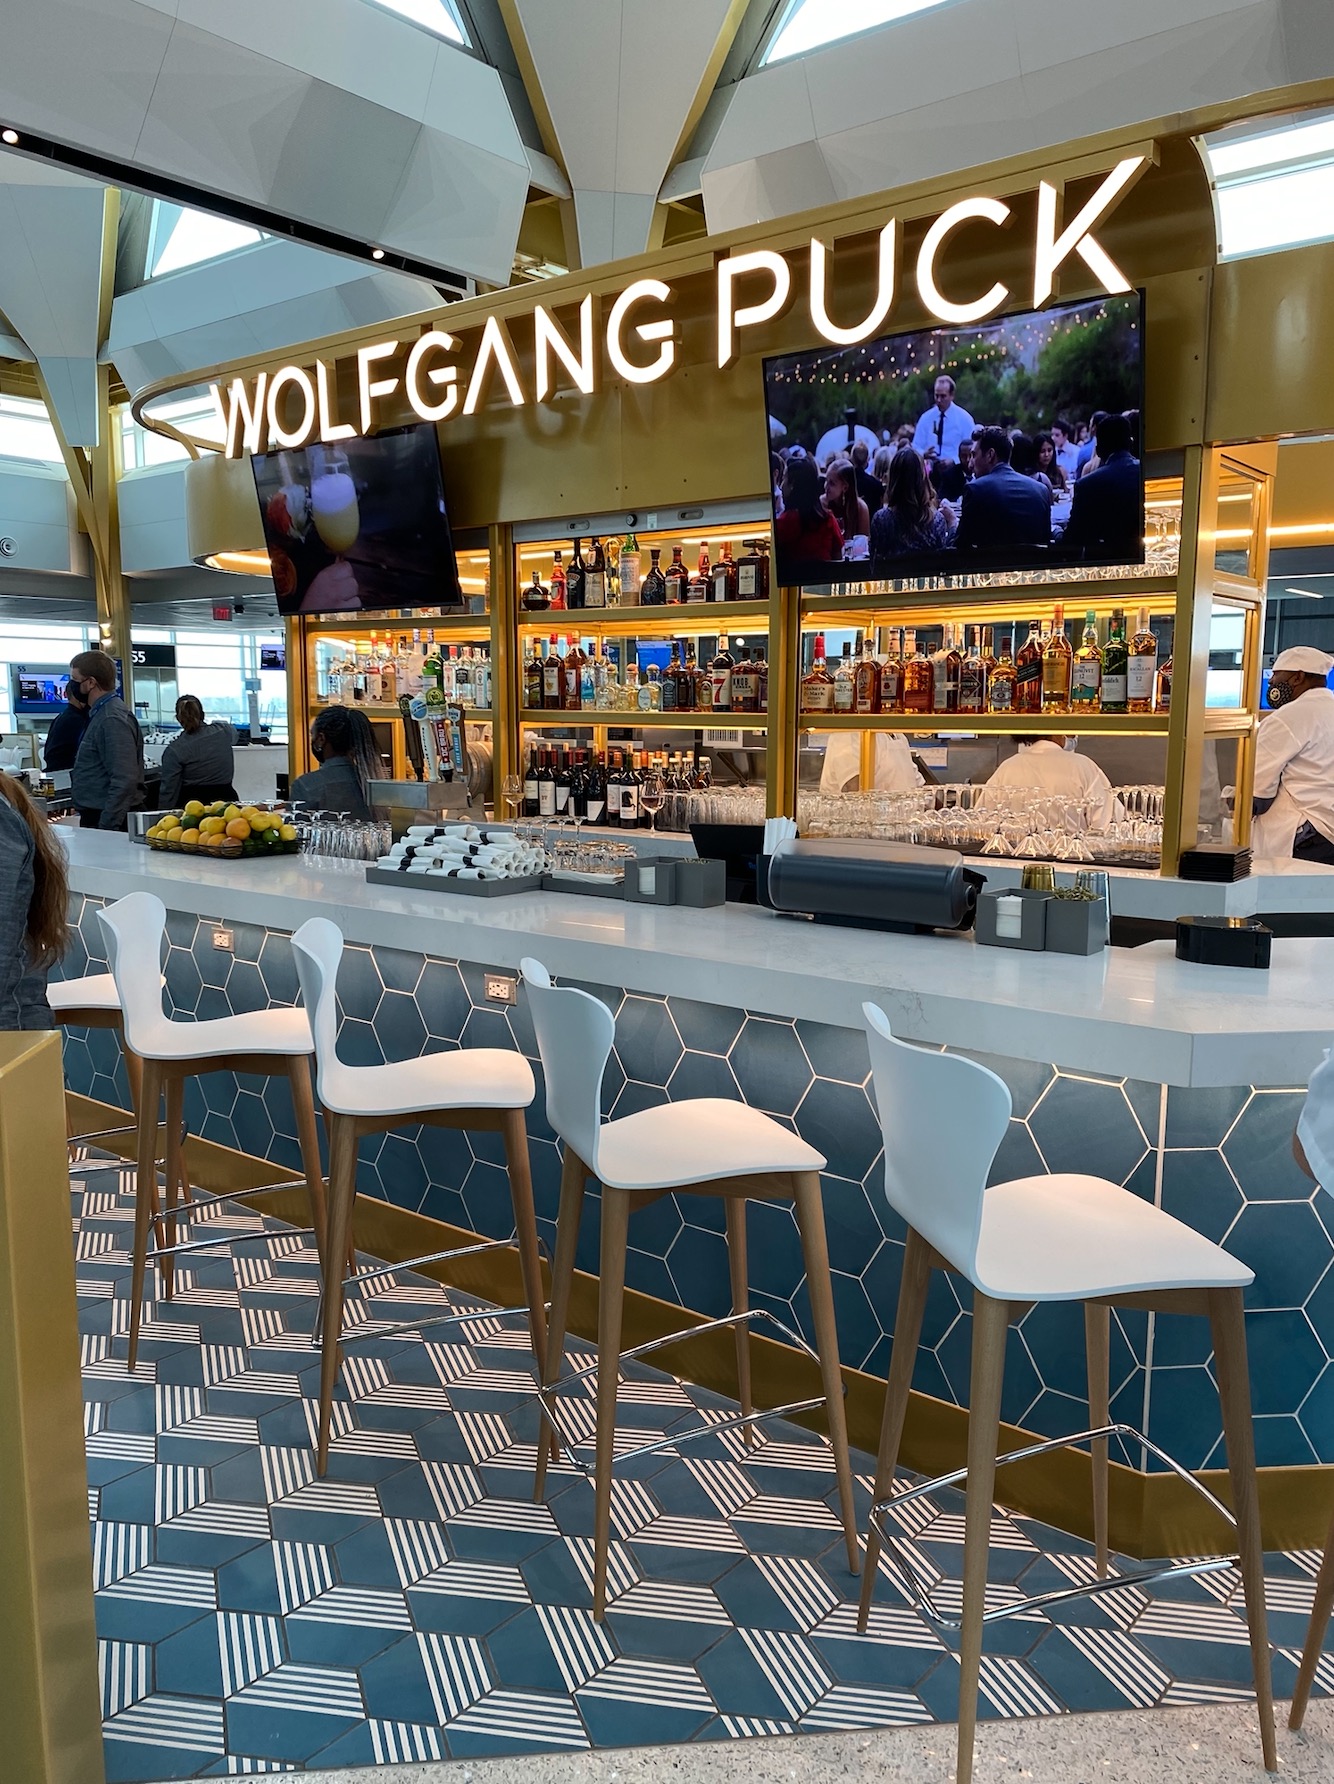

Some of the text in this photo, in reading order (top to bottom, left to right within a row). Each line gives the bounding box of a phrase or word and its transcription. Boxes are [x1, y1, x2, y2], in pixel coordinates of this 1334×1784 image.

[209, 155, 1146, 460] WOLFGANG PUCK
[713, 678, 726, 704] 7
